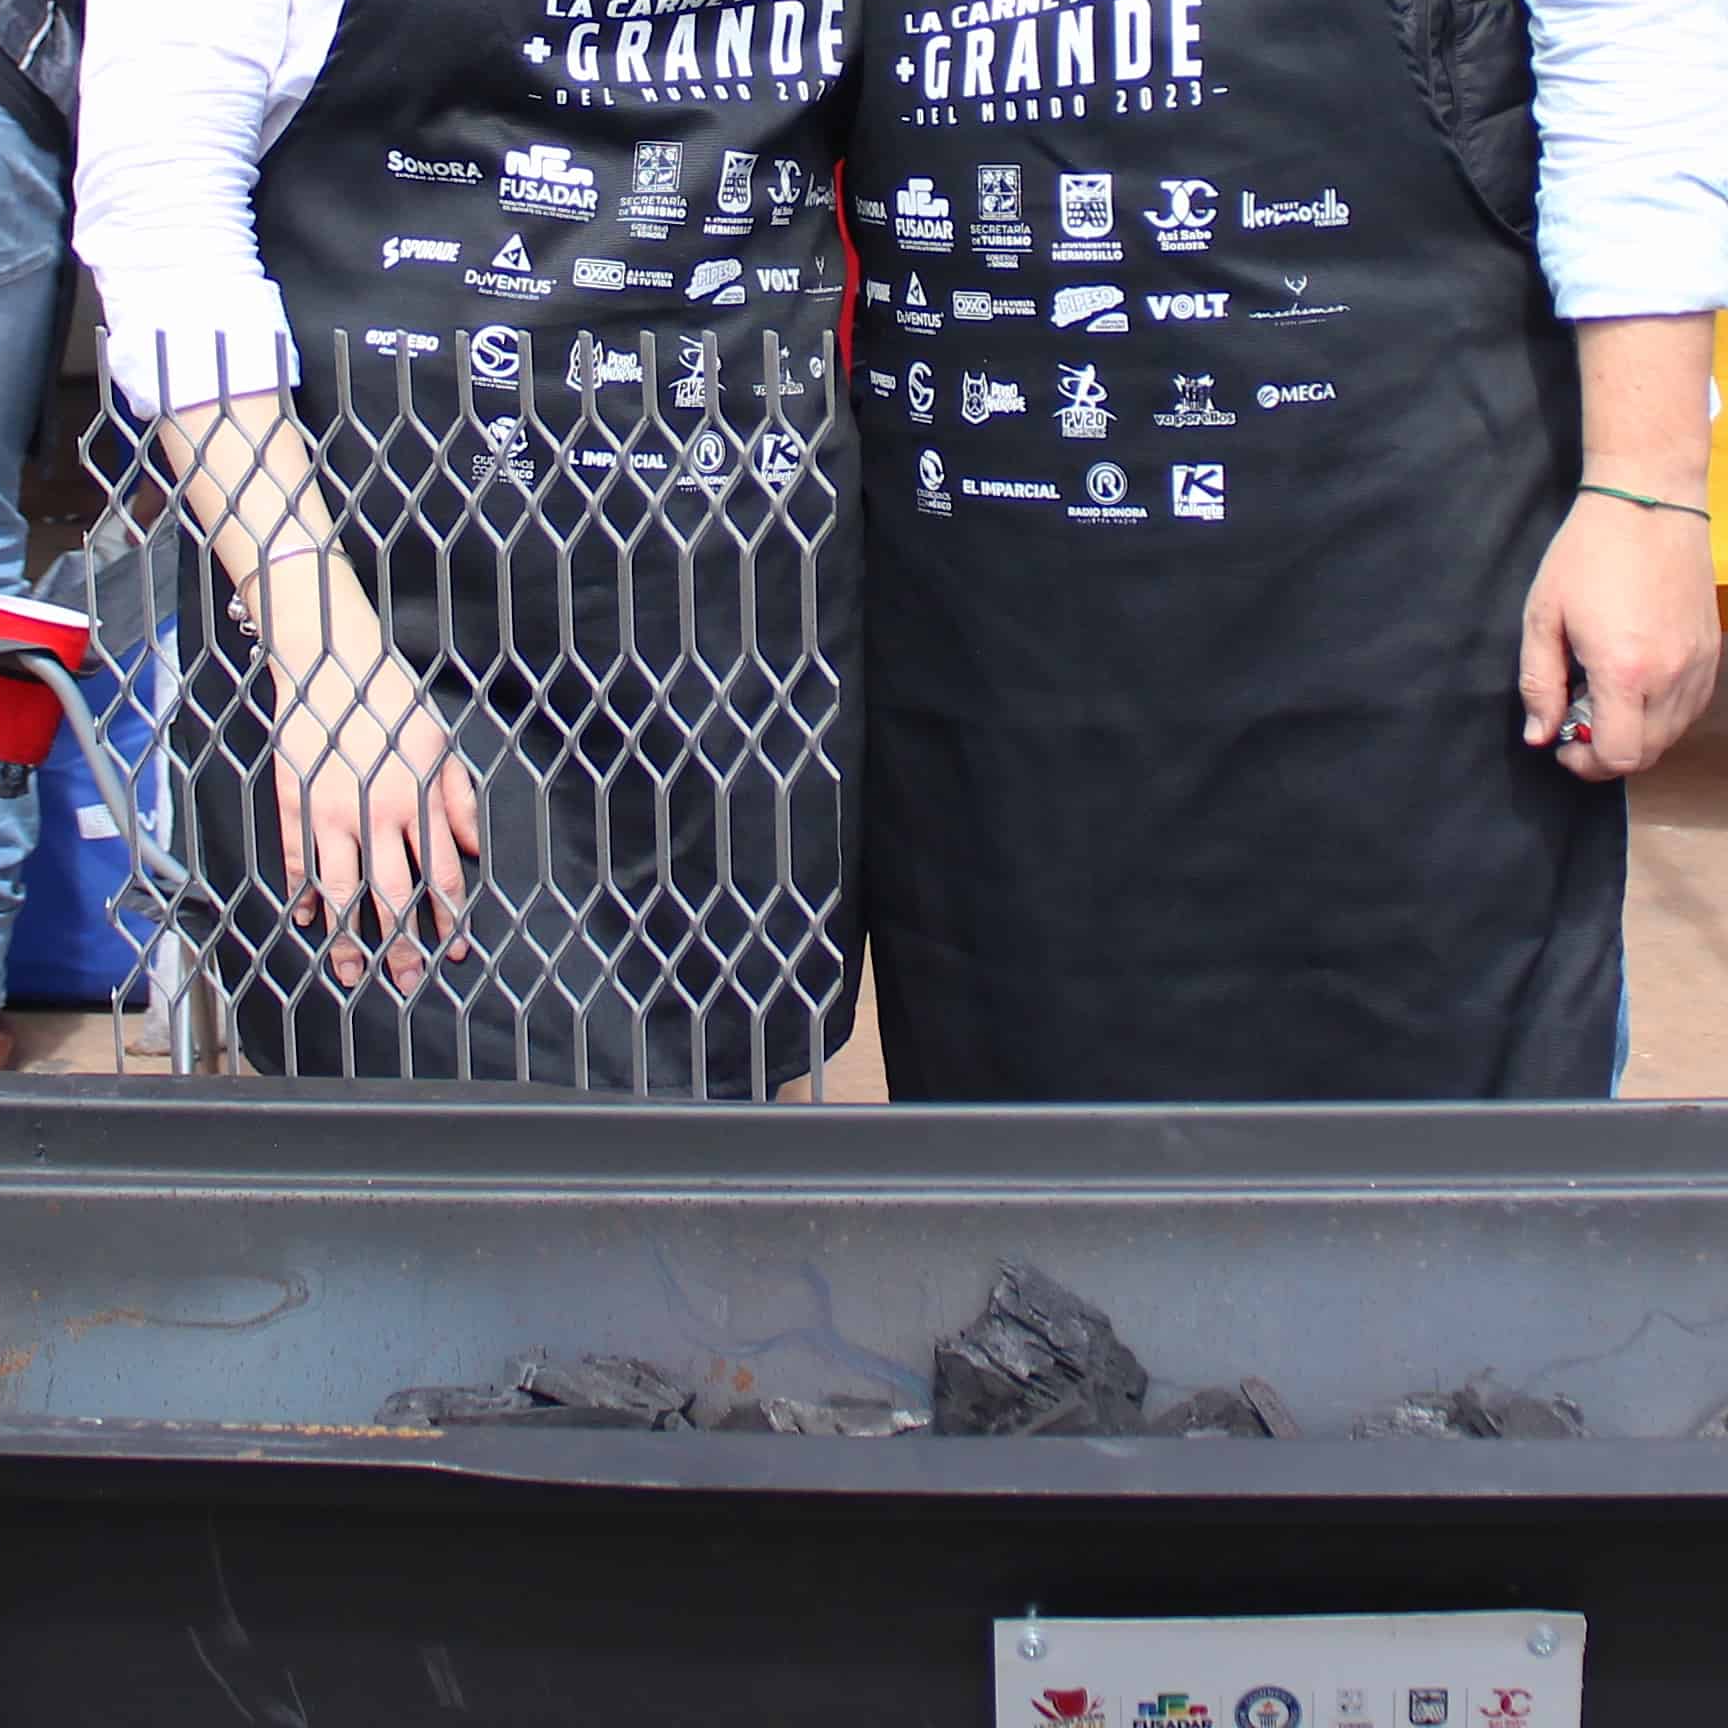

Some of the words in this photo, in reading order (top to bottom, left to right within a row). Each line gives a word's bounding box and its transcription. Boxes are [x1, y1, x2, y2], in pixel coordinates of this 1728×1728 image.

[904, 11, 943, 35] LA
[556, 87, 615, 106] DEL
[917, 104, 959, 125] DEL
[981, 94, 1086, 122] MUNDO
[1115, 80, 1203, 114] 2023
[499, 177, 598, 210] FUSADAR
[619, 195, 688, 208] SECRETARÍA
[630, 206, 687, 219] TURISMO
[1242, 188, 1350, 229] Hermosillo
[895, 217, 954, 241] FUSADAR
[970, 222, 1032, 235] SECRETARÍA
[980, 235, 1032, 247] TURISMO
[1052, 250, 1124, 262] HERMOSILLO
[576, 265, 622, 284] OXXO
[756, 269, 800, 292] VOLT
[955, 298, 990, 315] OXXO
[963, 478, 979, 495] EL
[980, 480, 1061, 500] IMPARCIAL
[1068, 506, 1101, 517] RADIO
[1102, 507, 1148, 519] SONORA
